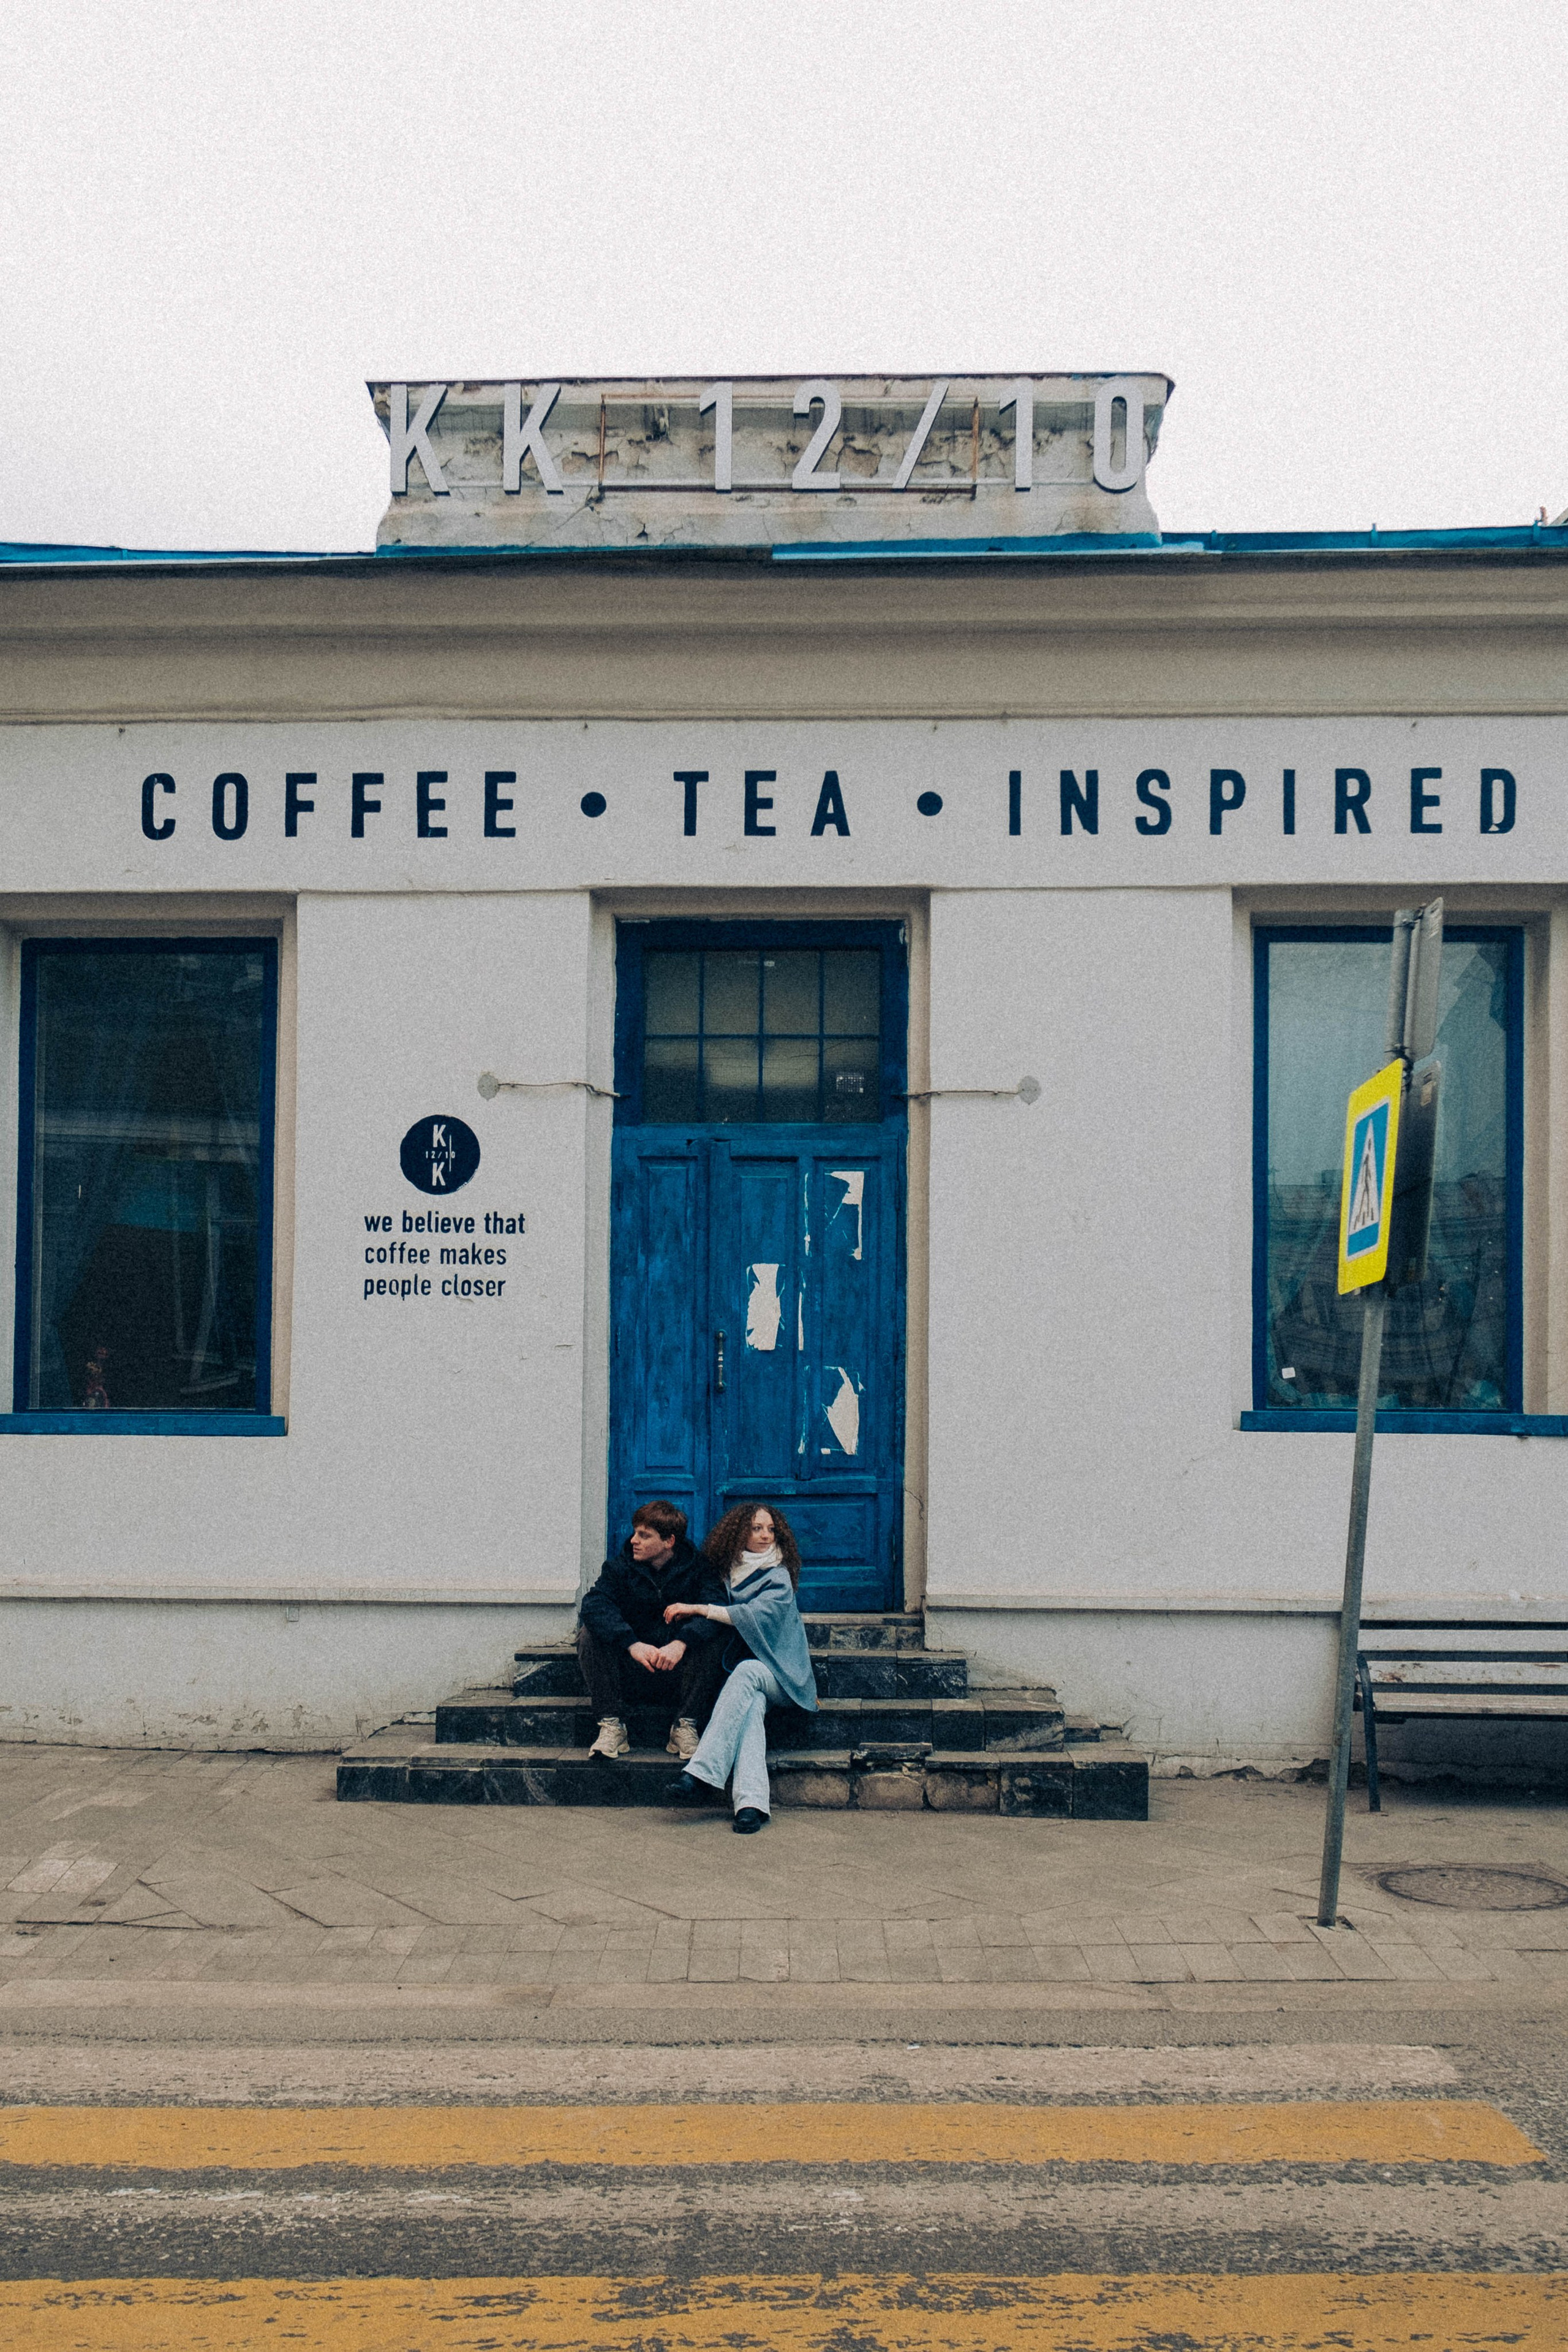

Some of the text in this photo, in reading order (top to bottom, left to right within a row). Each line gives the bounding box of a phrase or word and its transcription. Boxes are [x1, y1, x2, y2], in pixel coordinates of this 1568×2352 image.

[141, 767, 1517, 841] COFFEE TEA INSPIRED
[432, 1124, 447, 1148] K
[432, 1161, 446, 1186] K
[364, 1210, 526, 1235] we believe that
[365, 1241, 507, 1265] coffee makes
[364, 1273, 507, 1301] people closer
